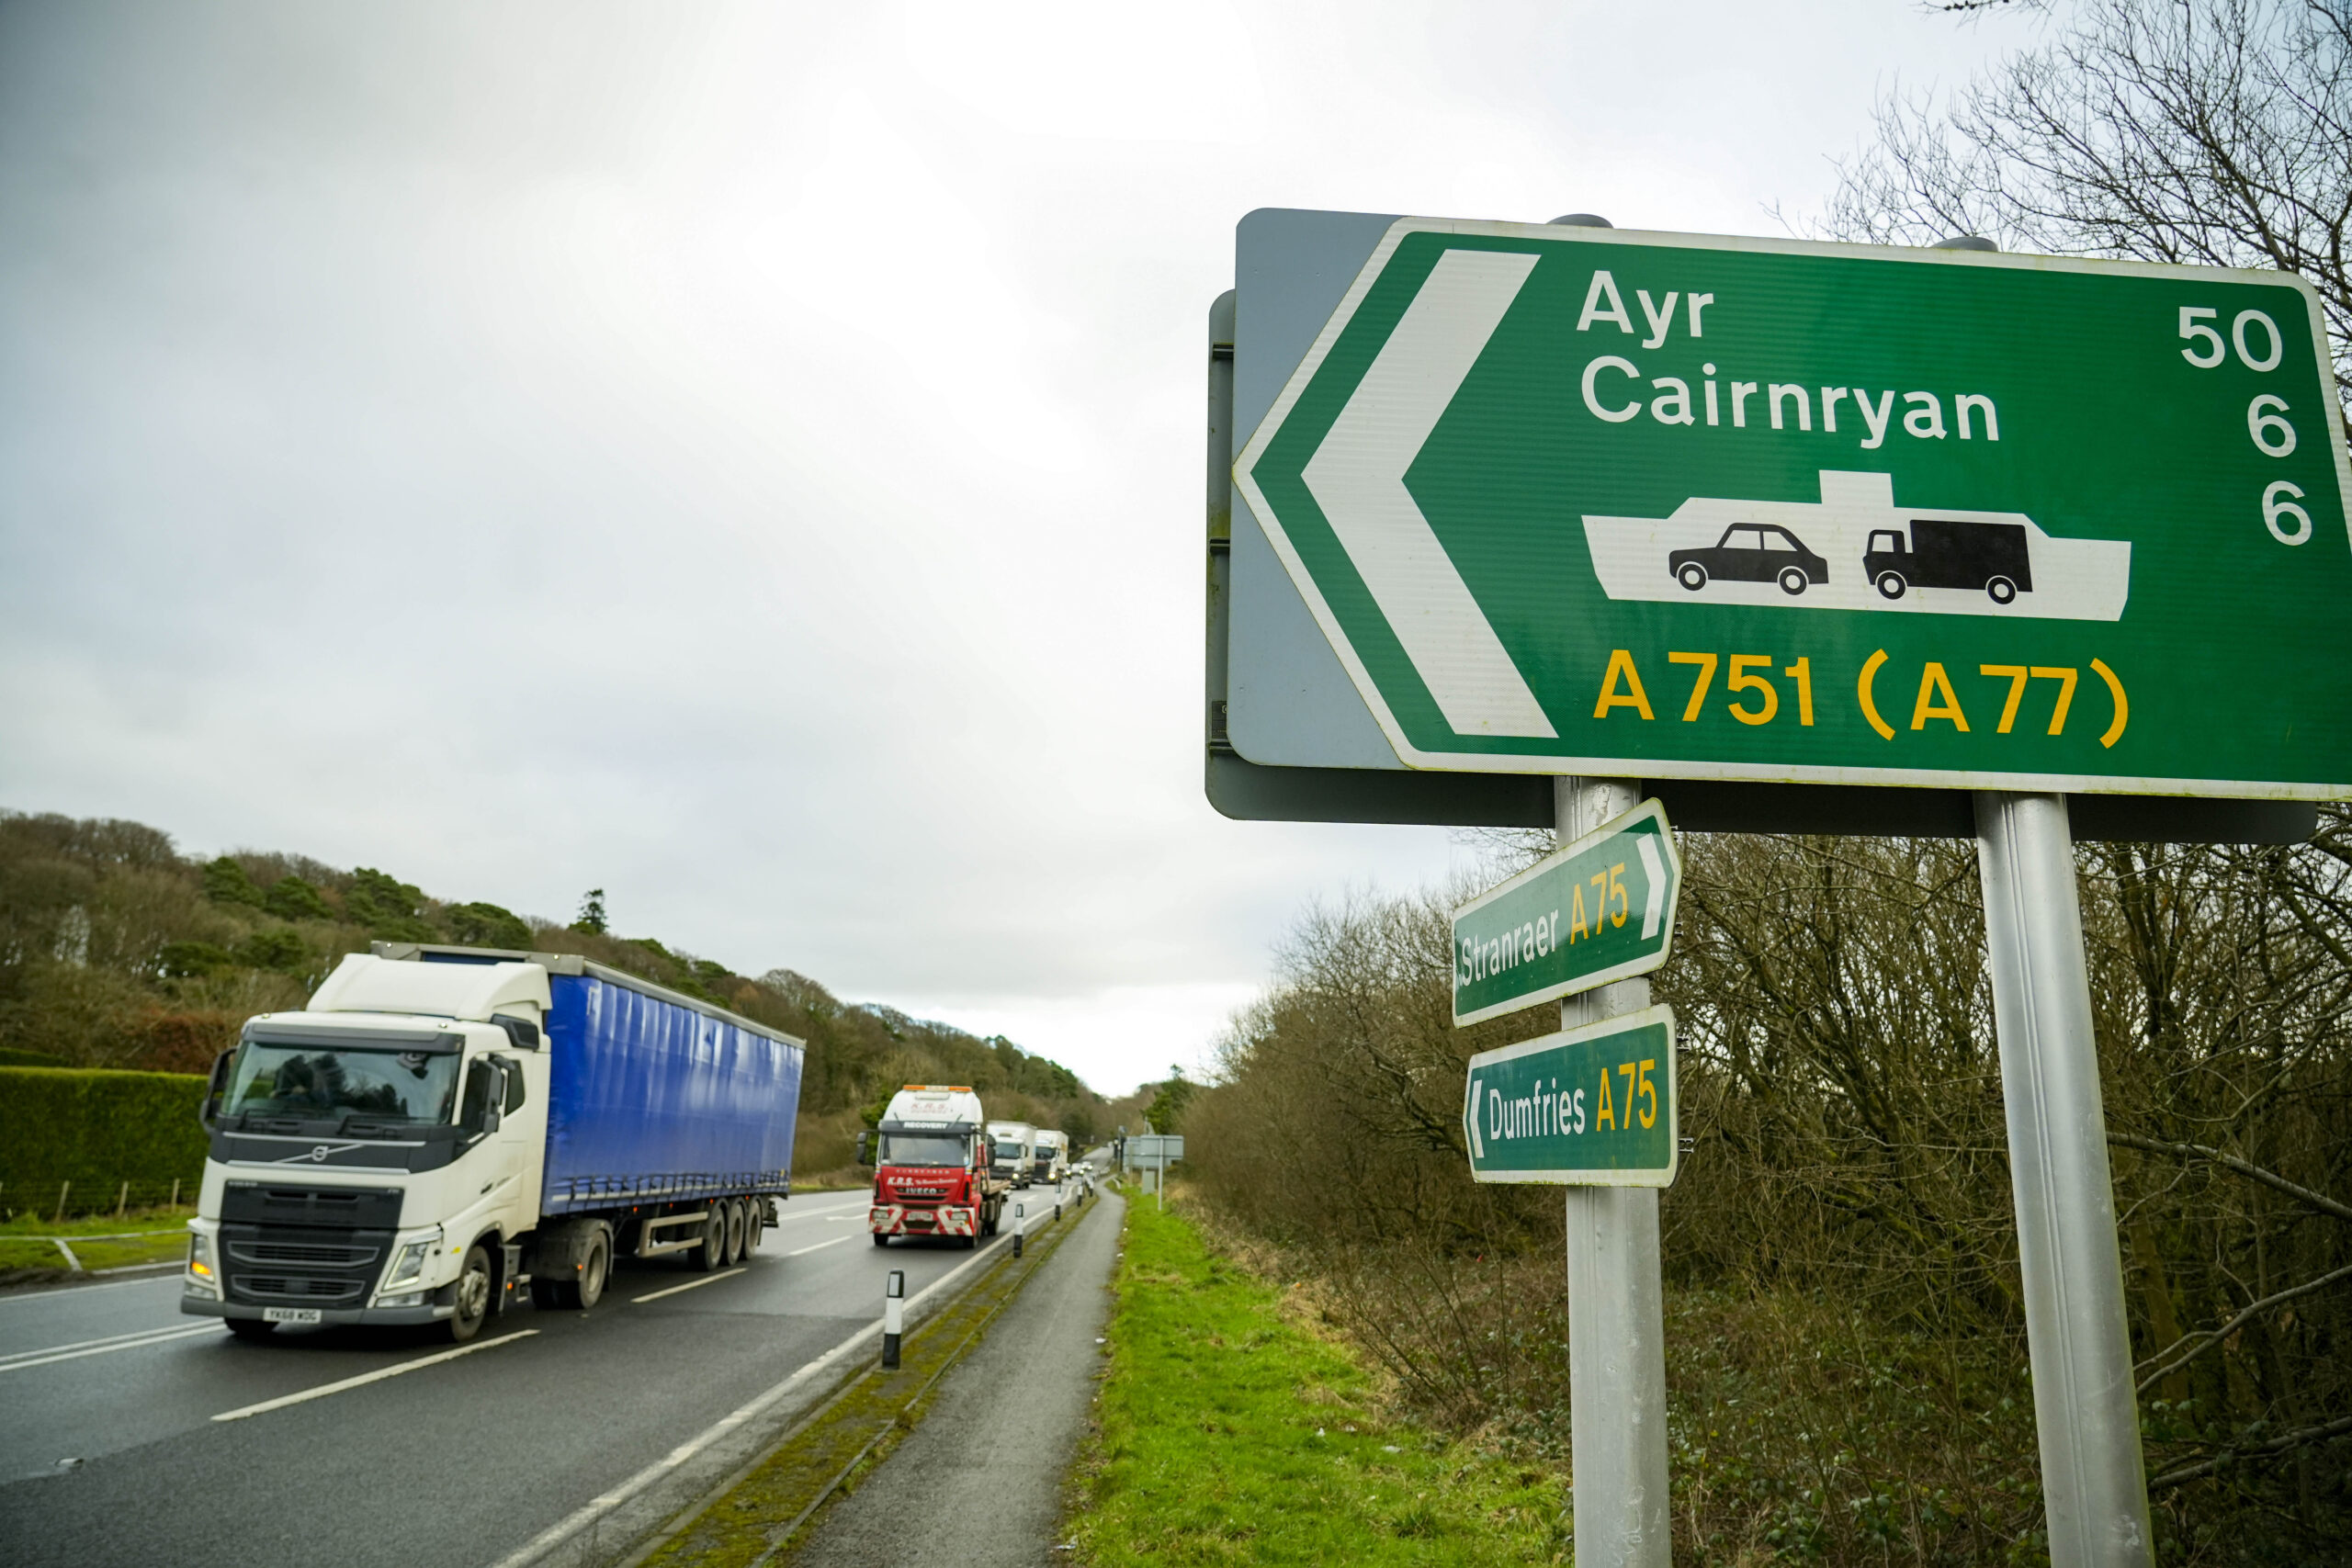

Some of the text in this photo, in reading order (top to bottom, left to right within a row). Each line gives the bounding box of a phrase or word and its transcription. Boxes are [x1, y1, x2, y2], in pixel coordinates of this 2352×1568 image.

[1576, 270, 2283, 372] Ayr 50
[1581, 355, 2297, 457] Cairnryan 6
[2262, 480, 2312, 546] 6
[1461, 862, 1628, 987] Stranraer A75
[903, 1121, 948, 1130] RECOVERY
[1489, 1058, 1657, 1140] Dumfries A75
[887, 1177, 914, 1187] K.R.S.
